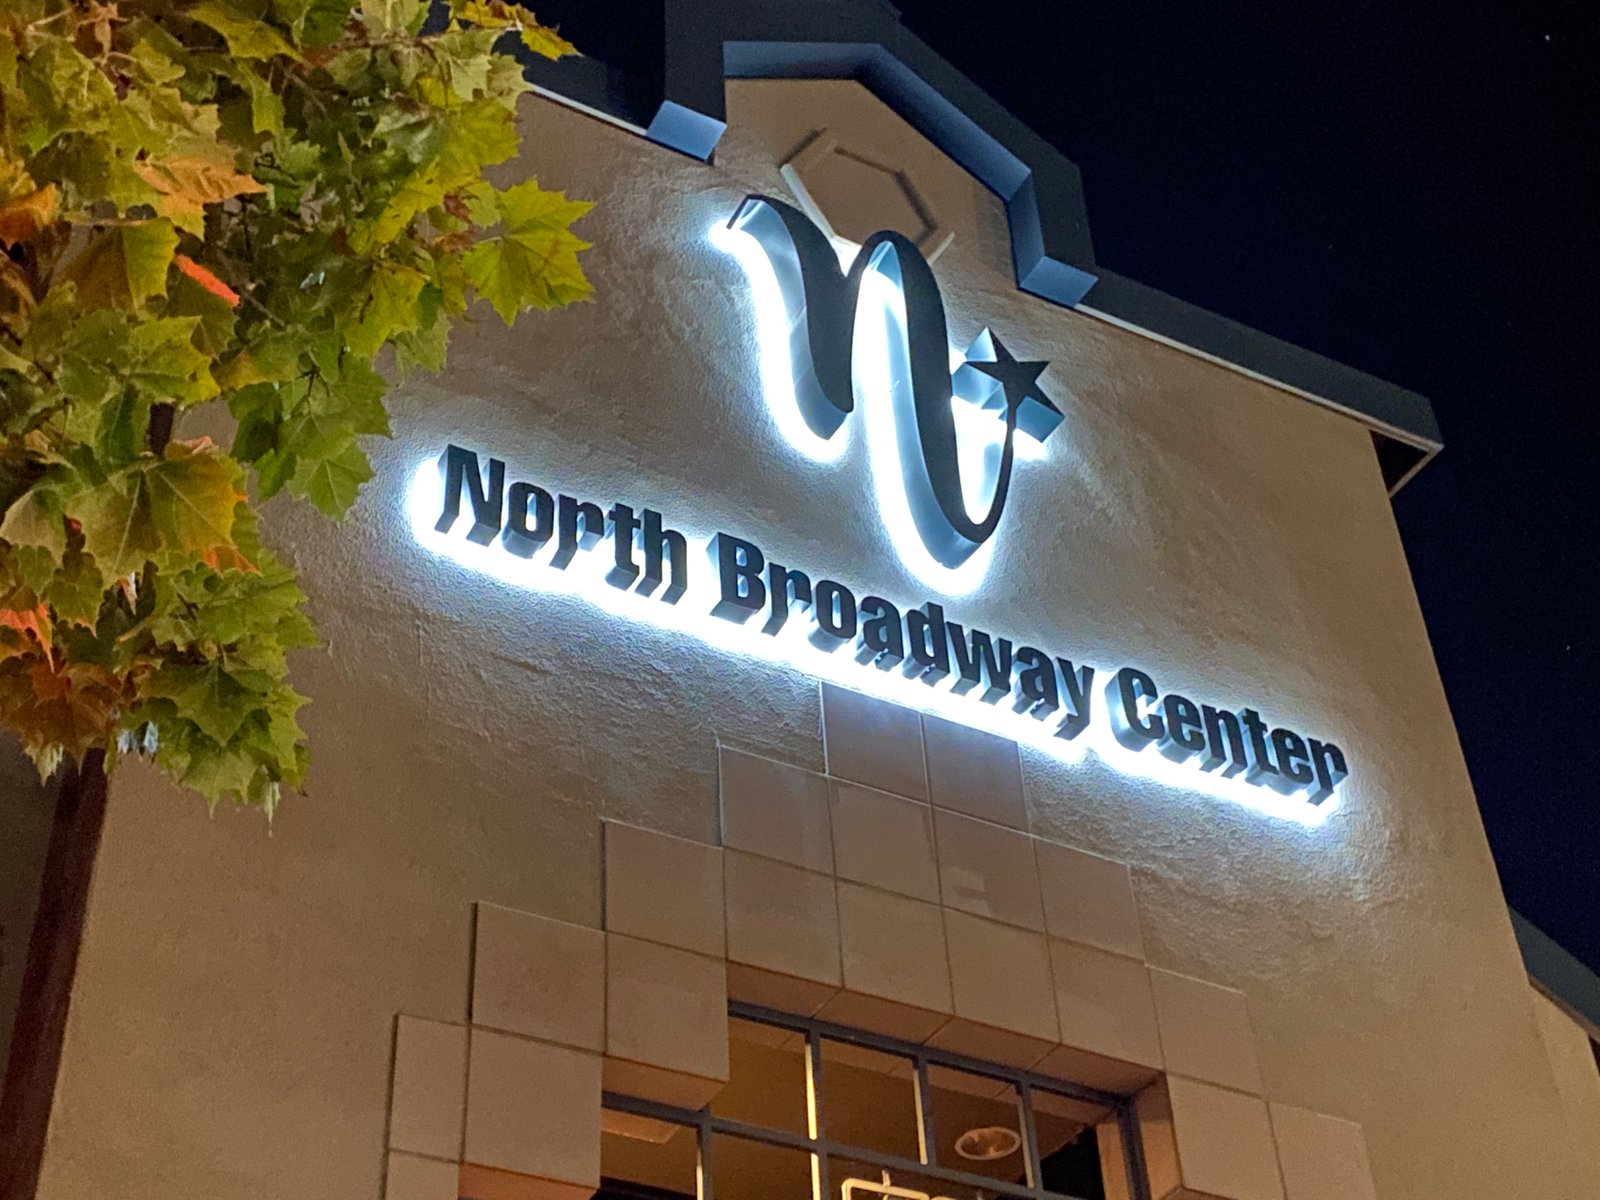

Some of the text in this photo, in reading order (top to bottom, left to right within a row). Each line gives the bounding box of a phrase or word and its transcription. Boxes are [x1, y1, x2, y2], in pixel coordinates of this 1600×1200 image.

[437, 444, 1348, 801] North Broadway Center
